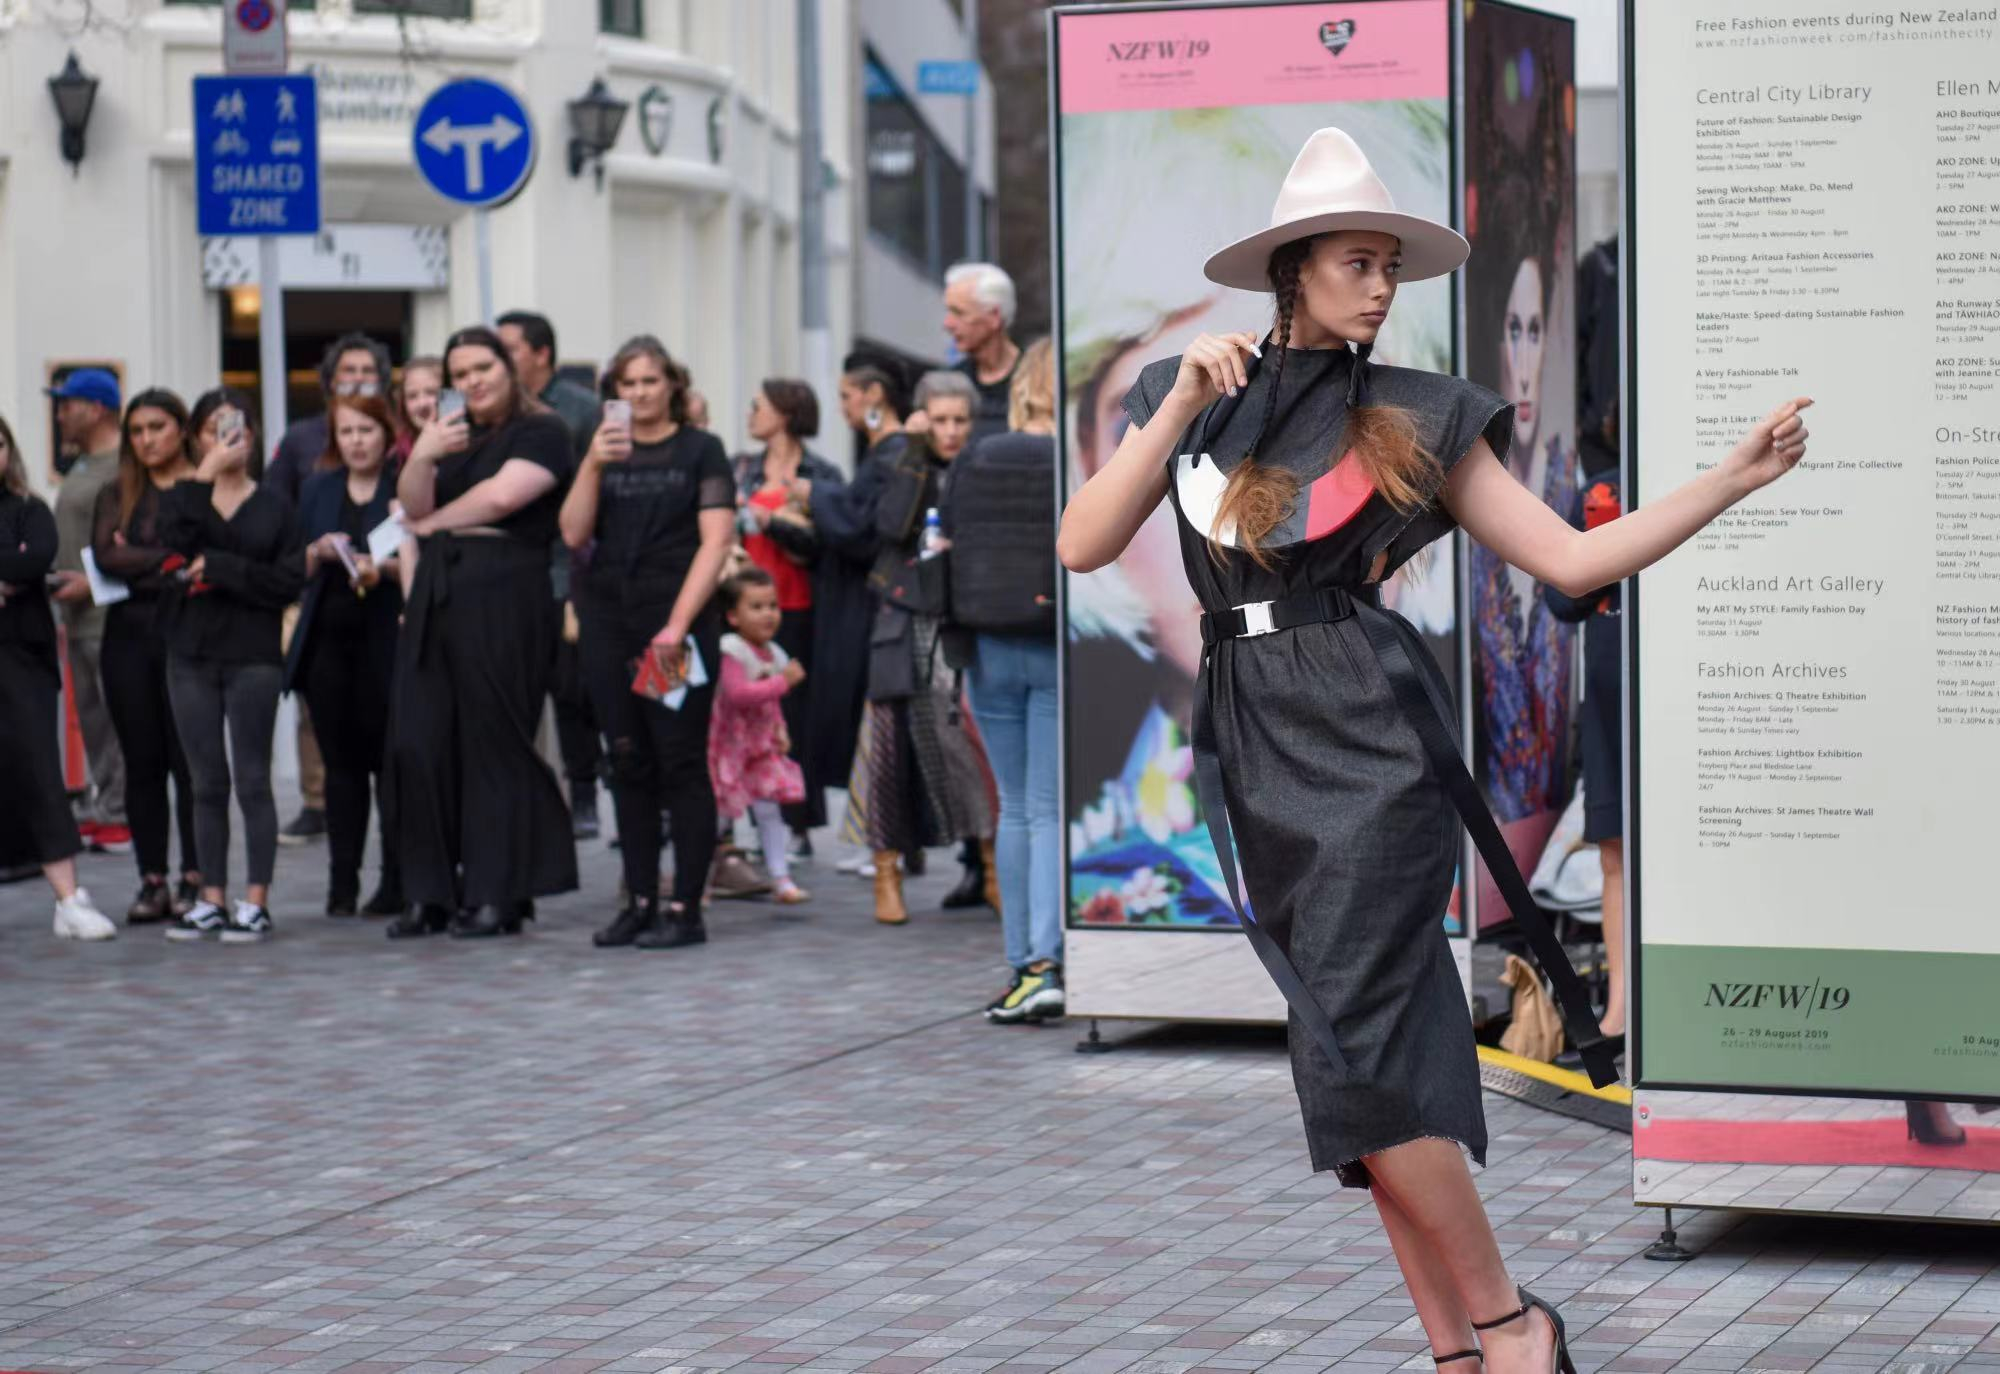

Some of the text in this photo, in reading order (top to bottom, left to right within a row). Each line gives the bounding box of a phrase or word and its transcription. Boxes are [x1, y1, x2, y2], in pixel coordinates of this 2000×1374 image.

[1696, 8, 1997, 32] Free Fashion events during New Zealand
[1937, 80, 1980, 96] Ellen
[1697, 84, 1871, 105] Central City Library
[1936, 110, 1958, 118] AHO
[1696, 118, 1725, 127] Future
[1726, 117, 1737, 125] of
[1777, 114, 1829, 123] Sustainable
[1831, 113, 1862, 123] Design
[1696, 128, 1741, 137] Exhibition
[1936, 158, 1956, 166] AKO
[212, 163, 303, 194] SHARED
[1697, 186, 1728, 196] Sewing
[1828, 182, 1854, 191] Mend
[1697, 196, 1792, 206] with Gracie Matthews
[229, 197, 288, 227] ZONE
[1937, 205, 1956, 214] AKO
[1697, 255, 1710, 263] 3D
[1752, 253, 1784, 261] Aritaua
[1786, 252, 1820, 261] Fashion
[1823, 251, 1874, 260] Accessories
[1936, 253, 1956, 261] AKO
[1957, 300, 1993, 309] Runway
[1754, 310, 1814, 320] Speed-dating
[1816, 309, 1868, 318] Sustainable
[1870, 308, 1904, 317] Fashion
[1936, 311, 1953, 319] and
[1696, 323, 1730, 331] Leaders
[1936, 358, 1955, 366] AKO
[1705, 370, 1724, 379] Very
[1727, 368, 1779, 376] Fashionable
[1696, 416, 1719, 425] Swap
[1799, 459, 1903, 471] Migrant Zine Collective
[1936, 457, 2000, 465] Fashion Police
[1780, 508, 1798, 516] Sew
[1800, 508, 1820, 516] Your
[1823, 508, 1843, 516] Own
[1719, 517, 1735, 528] The
[1737, 519, 1788, 527] Re-Creators
[1698, 576, 1883, 594] Auckland Art Gallery
[1697, 606, 1711, 615] My
[1713, 605, 1730, 613] ART
[1734, 606, 1747, 615] My
[1781, 605, 1810, 615] Family
[1812, 605, 1846, 613] Fashion
[1849, 606, 1866, 615] Day
[1937, 605, 1950, 613] NZ
[1953, 605, 1987, 614] Fashion
[1937, 616, 1968, 626] history
[1971, 616, 1980, 624] of
[1699, 662, 1847, 678] Fashion Archives
[1698, 691, 1731, 700] Fashion
[1775, 692, 1784, 700] Q
[1786, 692, 1820, 700] Theatre
[1822, 692, 1867, 700] Exhibition
[1699, 748, 1732, 757] Fashion
[1776, 749, 1815, 760] Lightbox
[1818, 750, 1862, 758] Exhibition
[1699, 806, 1732, 814] Fashion
[1777, 807, 1786, 815] St
[1819, 808, 1852, 816] Theatre
[1855, 808, 1874, 816] Wall
[1699, 817, 1742, 826] Screening
[1703, 976, 1851, 1019] NZFW/19
[1723, 1028, 1829, 1040] 26 29 August 2019
[1963, 1035, 1975, 1044] 30
